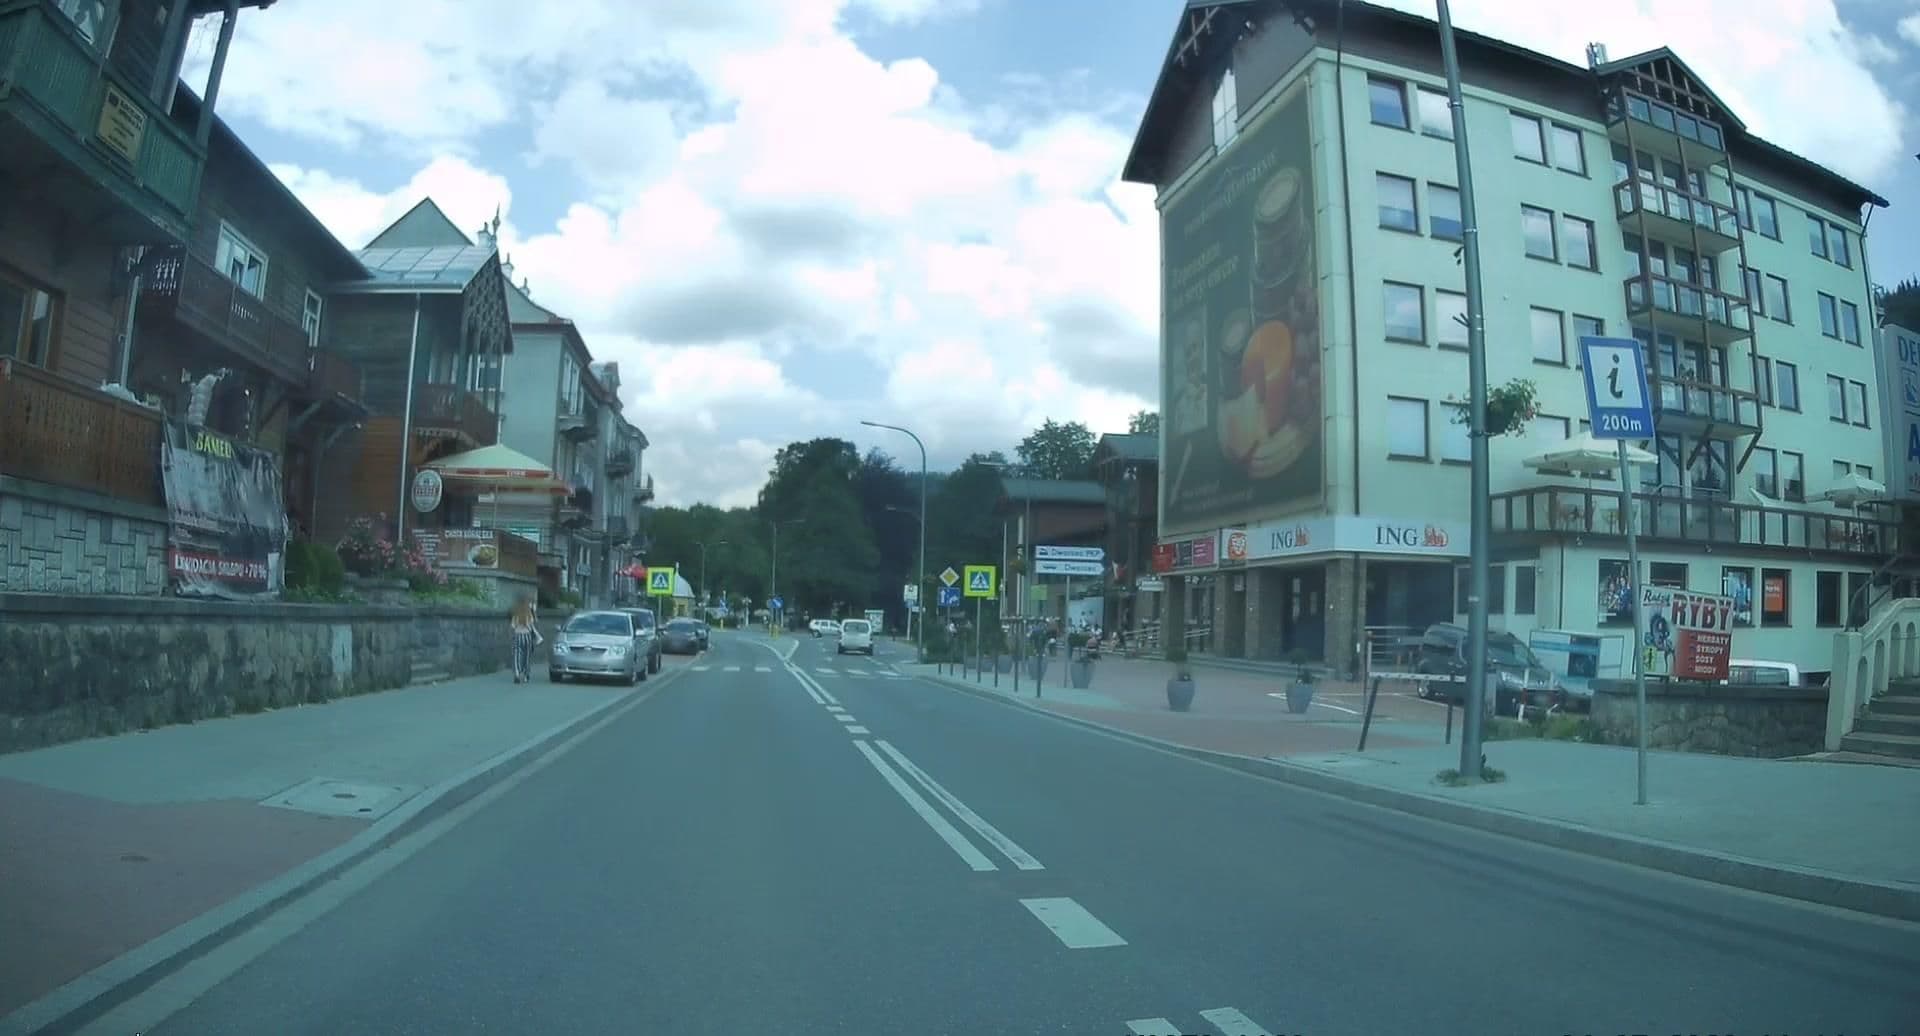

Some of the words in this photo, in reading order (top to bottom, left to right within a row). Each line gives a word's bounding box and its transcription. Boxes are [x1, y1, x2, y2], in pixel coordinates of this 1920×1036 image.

[1897, 335, 1920, 366] DE
[1602, 414, 1642, 431] 200m
[1271, 528, 1293, 550] ING
[1376, 526, 1418, 546] ING
[1671, 593, 1732, 631] RYBY
